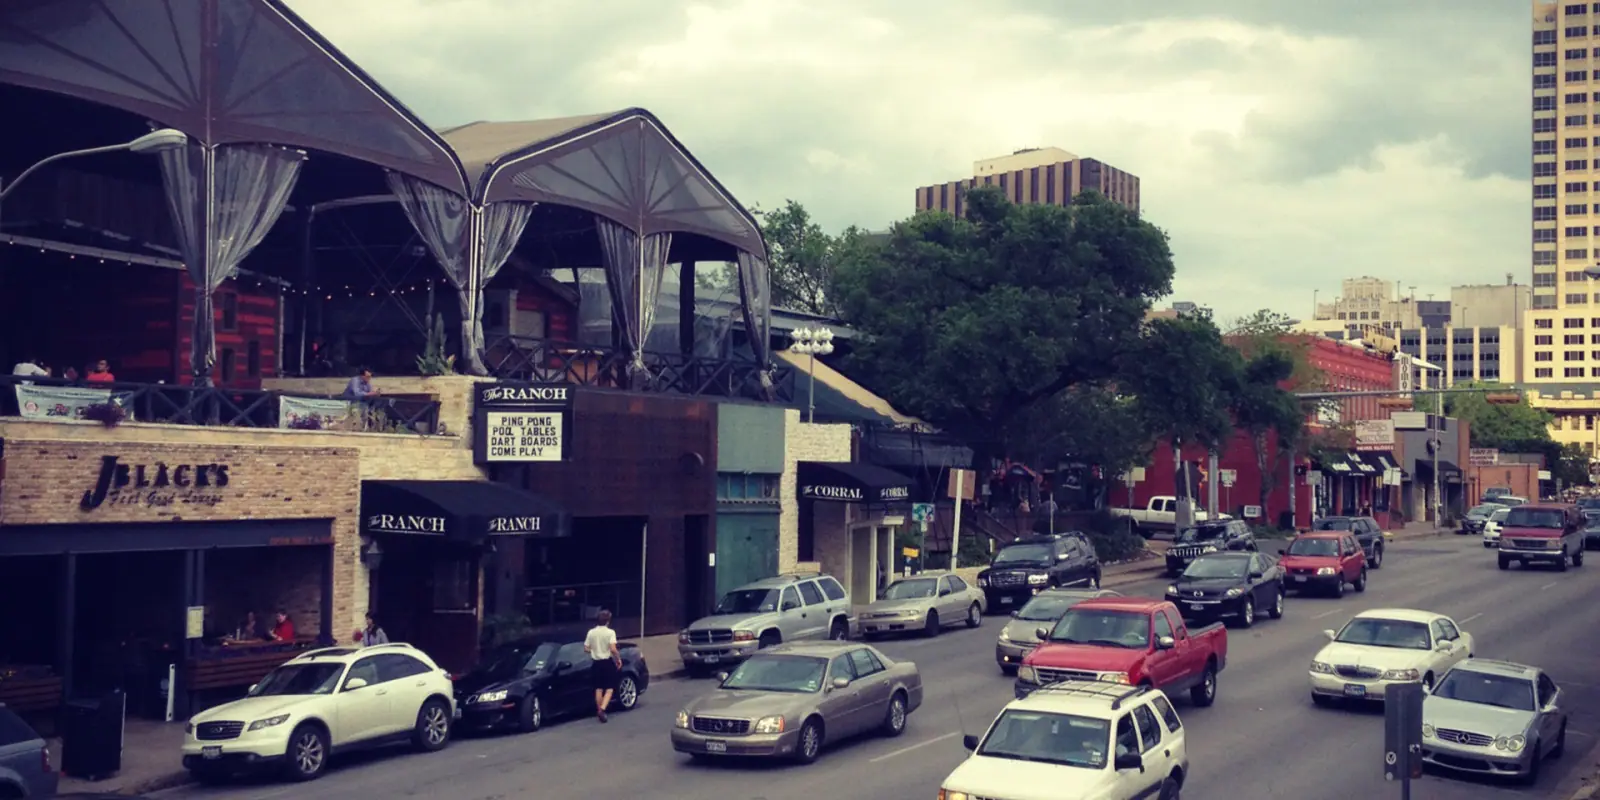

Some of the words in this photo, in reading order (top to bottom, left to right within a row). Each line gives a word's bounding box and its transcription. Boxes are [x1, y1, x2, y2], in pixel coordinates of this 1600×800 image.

[482, 386, 502, 402] The
[502, 387, 567, 400] RANCH
[501, 416, 523, 426] PING
[527, 416, 552, 426] PONG
[492, 427, 514, 436] POOL
[520, 427, 556, 436] TABLES
[491, 437, 516, 446] DART
[520, 437, 558, 446] BOARDS
[491, 447, 516, 456] COME
[519, 447, 544, 456] PLAY
[814, 485, 863, 499] CORRAL
[886, 486, 909, 498] CORRAL
[381, 514, 446, 533] RANCH
[497, 516, 541, 532] RANCH
